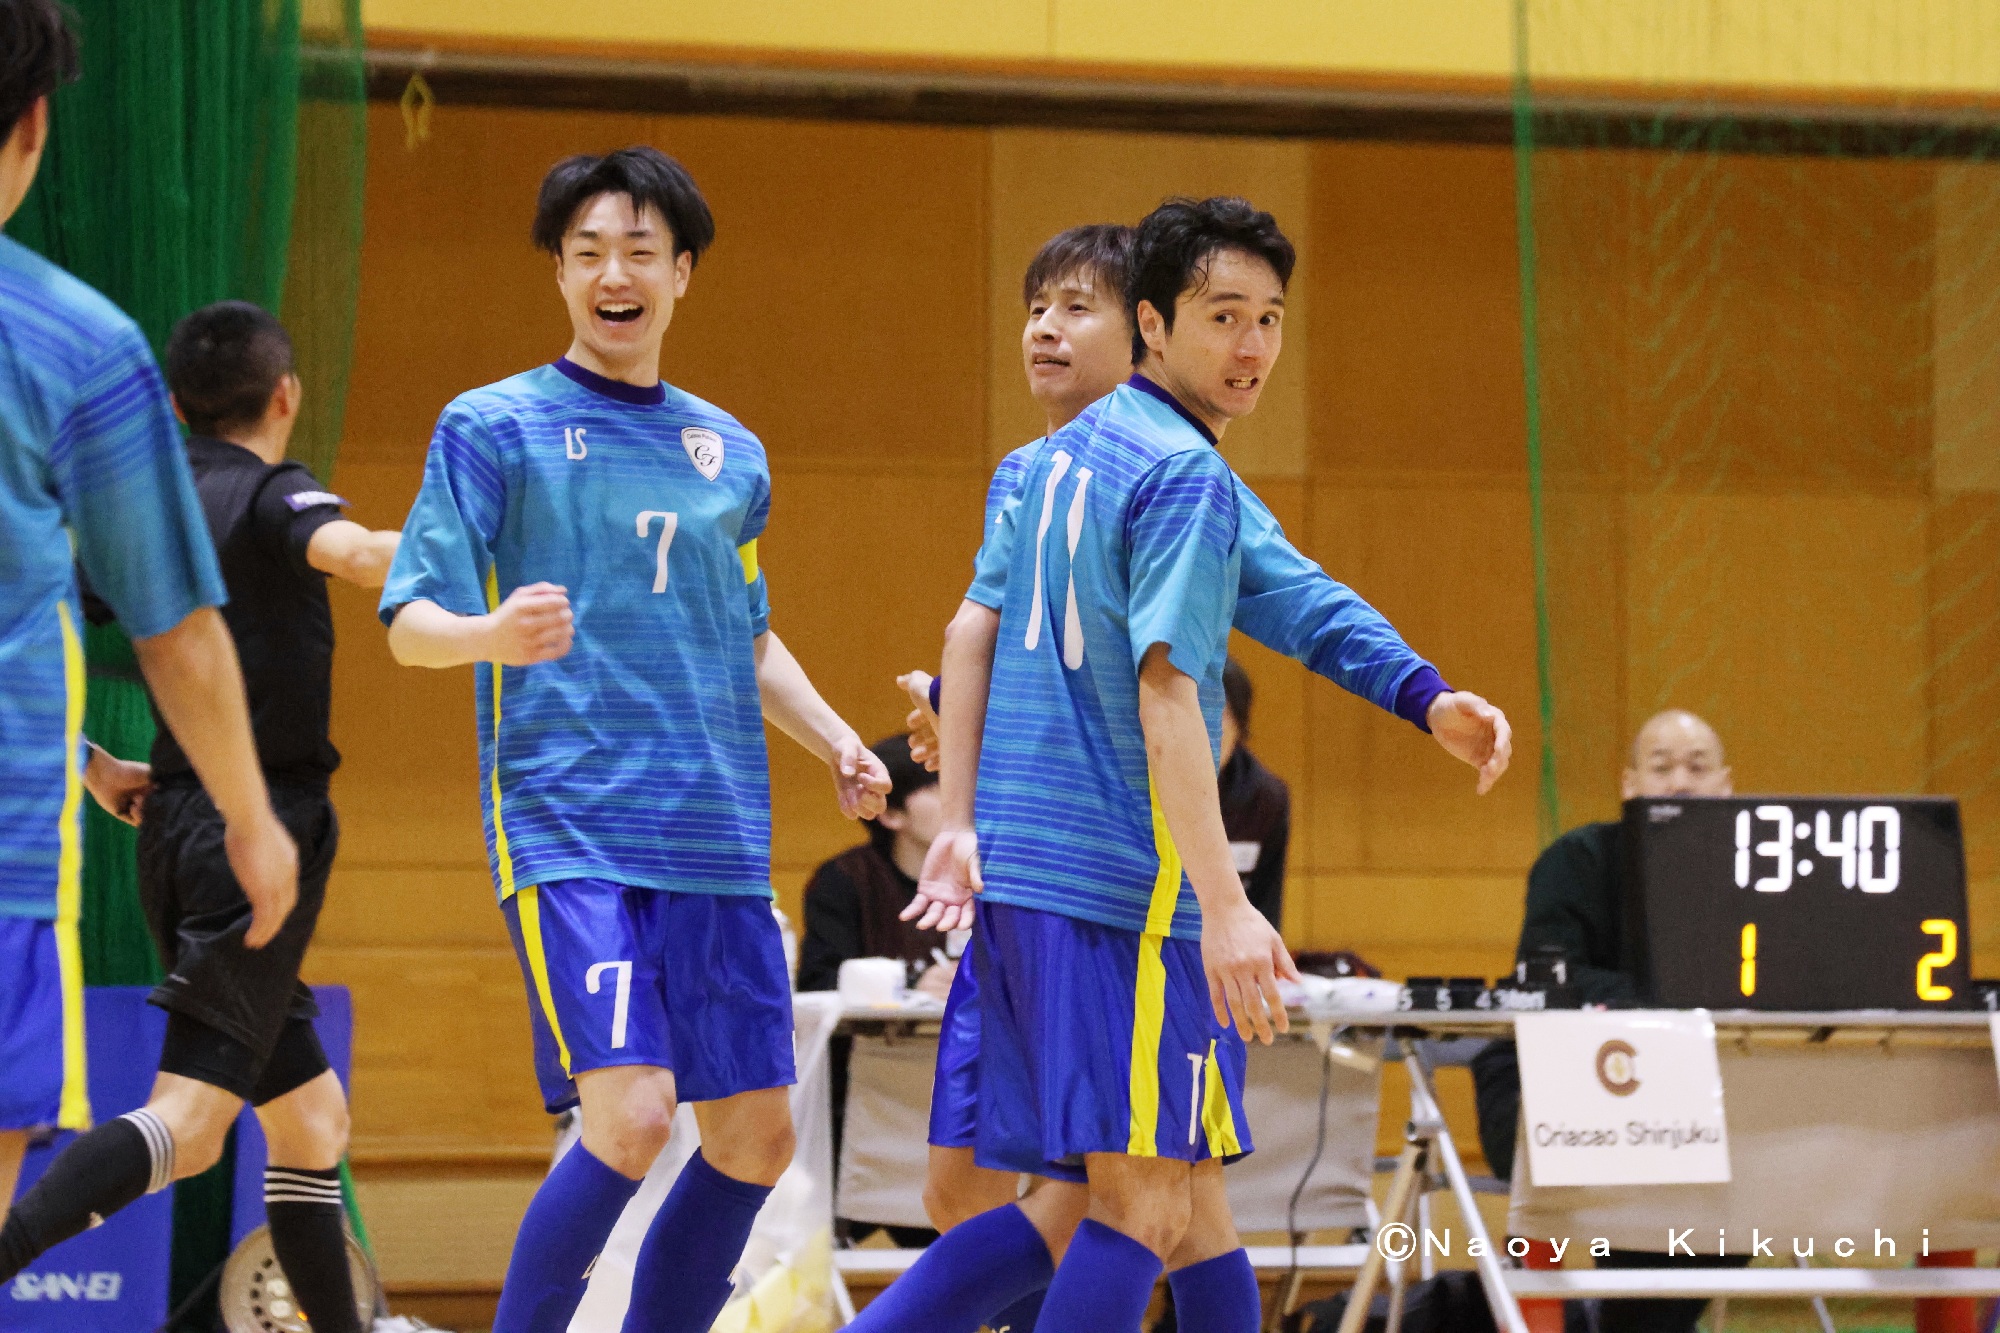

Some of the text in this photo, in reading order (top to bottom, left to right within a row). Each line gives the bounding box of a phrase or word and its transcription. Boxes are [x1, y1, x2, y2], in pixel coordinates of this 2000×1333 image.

[636, 510, 677, 593] 7
[1024, 450, 1094, 670] 11
[1735, 806, 1900, 893] 13:40
[1740, 919, 1957, 1001] 1 2
[585, 961, 633, 1049] 7
[1535, 1120, 1720, 1150] Criacao Shinjuku
